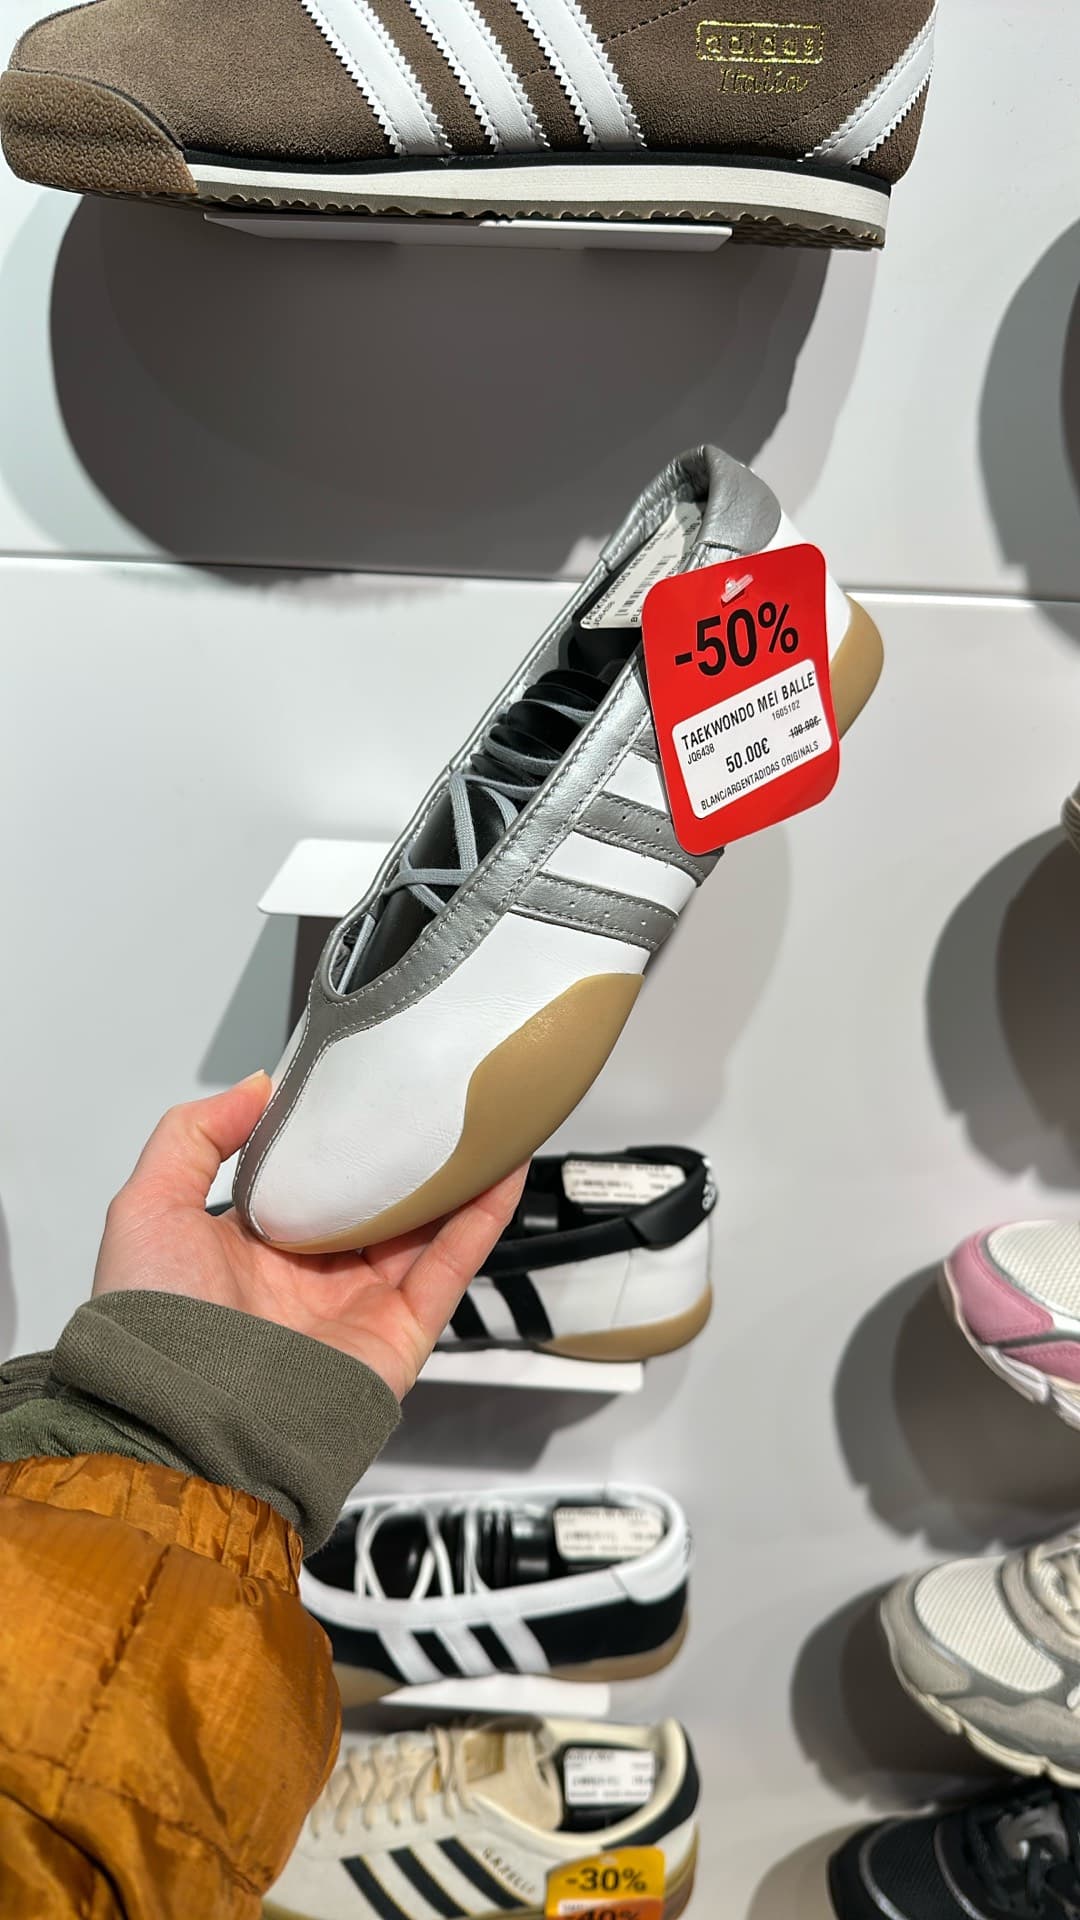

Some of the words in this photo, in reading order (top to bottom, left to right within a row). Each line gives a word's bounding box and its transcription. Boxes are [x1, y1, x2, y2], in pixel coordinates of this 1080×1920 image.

[704, 29, 815, 56] adidas
[675, 601, 799, 676] -50%
[681, 702, 755, 750] TAEKWONDO
[757, 689, 779, 713] MEI
[781, 671, 815, 701] BALLE
[772, 700, 801, 721] 1605102
[687, 743, 715, 765] JQ6438
[725, 737, 770, 773] 50.00€
[781, 740, 819, 768] ORIGINALS
[565, 1866, 647, 1893] -30%
